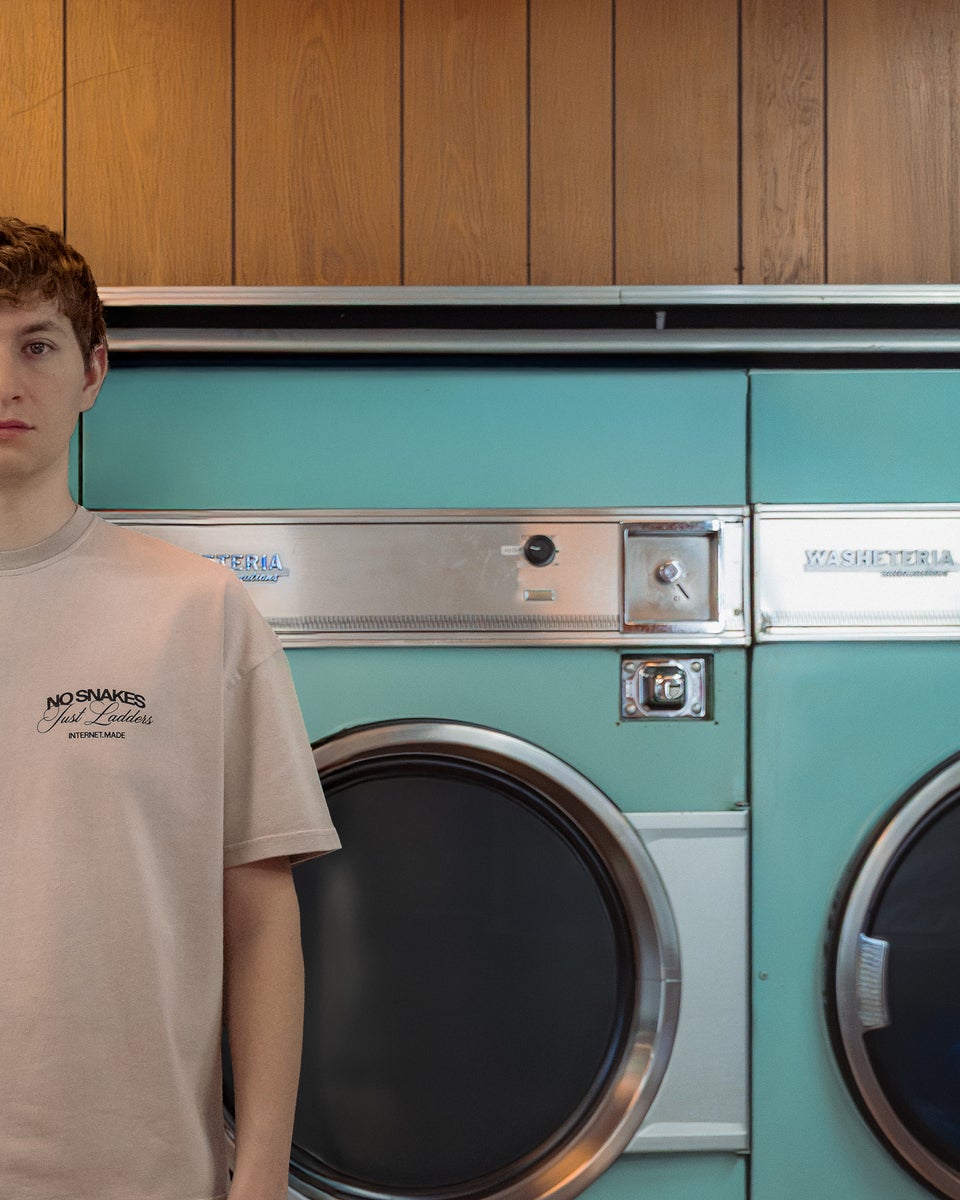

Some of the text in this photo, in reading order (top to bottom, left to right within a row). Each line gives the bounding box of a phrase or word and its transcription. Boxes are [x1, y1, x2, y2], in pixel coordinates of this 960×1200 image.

[804, 549, 955, 567] WASHETERIA
[46, 688, 146, 711] NO SNAKES
[36, 700, 154, 734] Just Ladders
